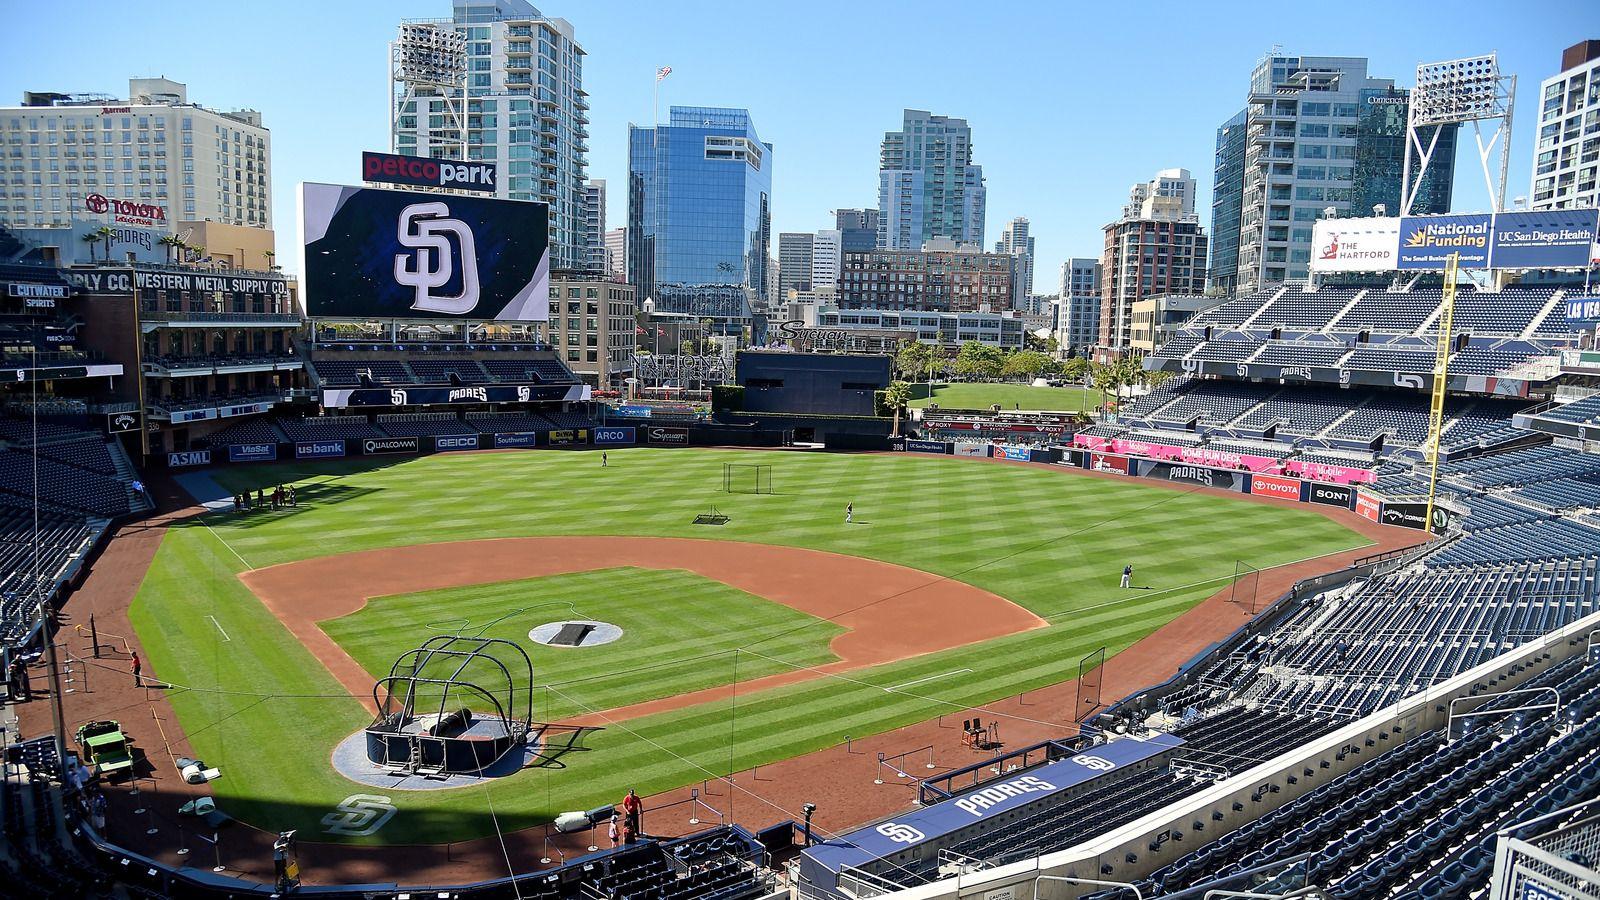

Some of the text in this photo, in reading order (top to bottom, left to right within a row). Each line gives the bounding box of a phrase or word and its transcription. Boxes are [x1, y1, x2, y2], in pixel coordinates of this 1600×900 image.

[101, 107, 131, 115] Marriott
[111, 199, 166, 220] TOYOTA
[1427, 221, 1488, 235] National
[110, 228, 152, 252] PADRES
[1426, 234, 1486, 248] Funding
[1498, 229, 1591, 242] UC San Diego Health
[1341, 242, 1358, 250] THE
[1339, 250, 1390, 260] HARTFORD
[135, 272, 289, 295] WESTERN METAL SUPPLY CO.
[17, 284, 64, 297] CUTWATER
[26, 298, 56, 308] SPIRITS
[1567, 302, 1583, 319] LAS
[779, 320, 849, 345] Sycuan
[628, 353, 736, 369] NATIONAL
[1280, 366, 1312, 380] PADRES
[449, 386, 488, 402] PADRES
[596, 432, 624, 440] ARCO
[652, 428, 685, 441] Sycuan
[366, 440, 416, 452] QUALCOMM
[437, 438, 477, 448] GEICO
[170, 452, 210, 467] ASML
[1181, 448, 1241, 463] HOME RUN DECK
[1169, 466, 1213, 486] PADRES
[1266, 483, 1298, 494] TOYOTA
[1316, 489, 1349, 501] SONY
[1404, 514, 1426, 522] CORNER
[954, 776, 1057, 817] PADRES
[988, 892, 1010, 900] CAUTION
